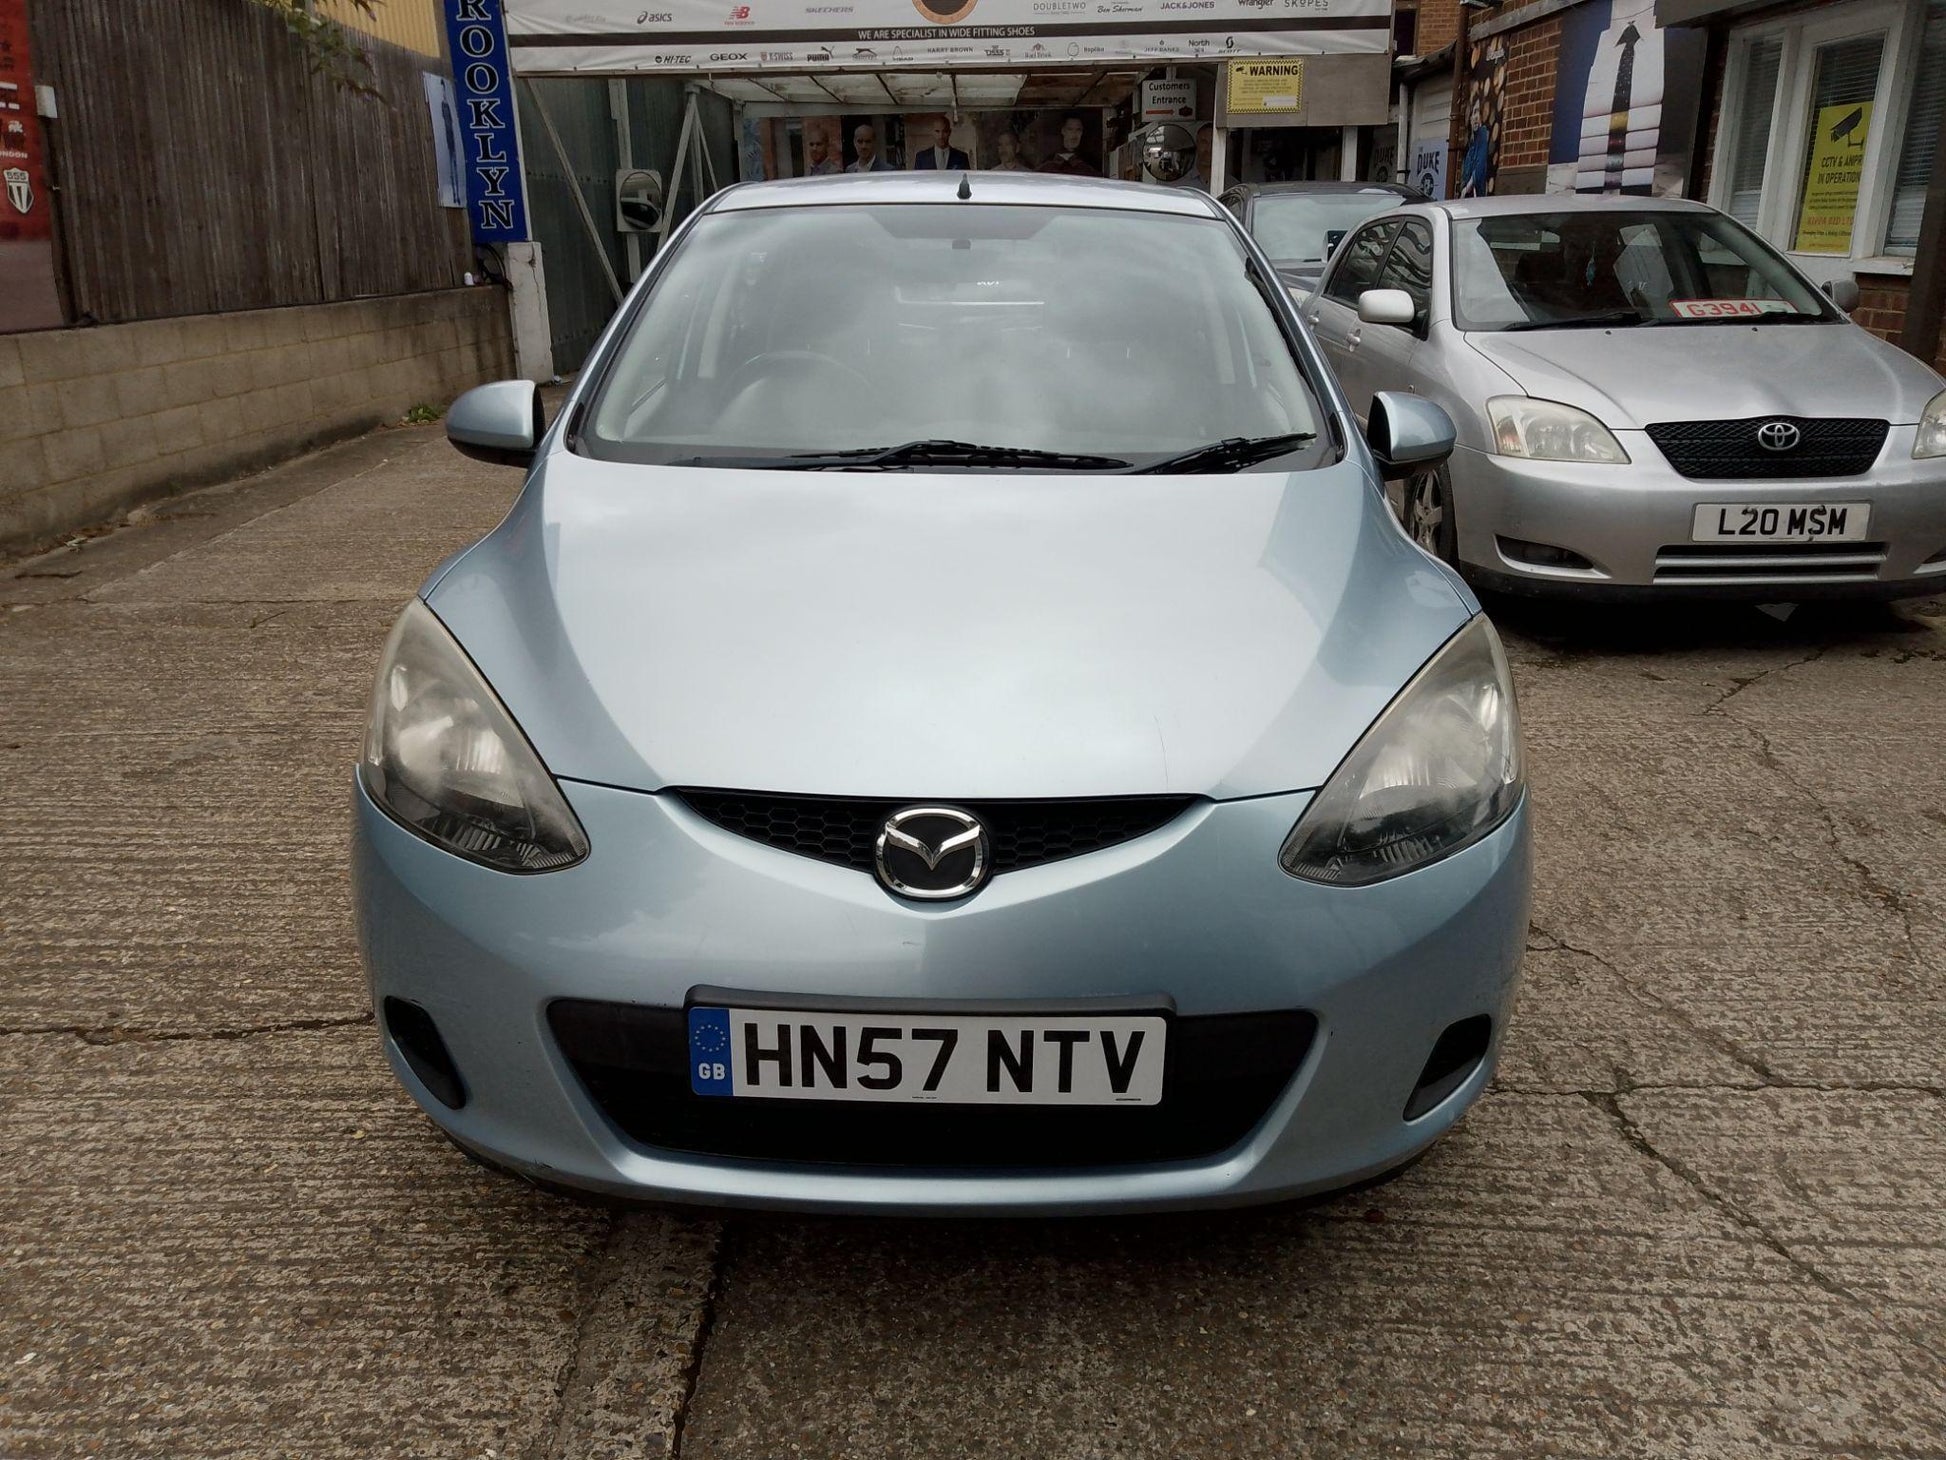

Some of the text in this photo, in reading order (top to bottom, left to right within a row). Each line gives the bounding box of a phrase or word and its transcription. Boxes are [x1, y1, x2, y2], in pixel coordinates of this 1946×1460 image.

[1033, 2, 1087, 11] DOUBLETWO
[1097, 5, 1143, 13] Ben Sherman
[1160, 1, 1215, 10] JACK&JONES
[858, 26, 1036, 40] WE ARE SPECIALIST IN WIDE FITTING SHOES
[1188, 39, 1210, 47] North
[663, 55, 692, 64] HI-TEC
[709, 53, 750, 62] GEOX
[1249, 65, 1299, 76] WARNING
[1148, 82, 1191, 91] Customers
[1152, 95, 1187, 105] Entrance
[456, 0, 515, 229] ROOKLYN
[0, 150, 28, 159] NDON
[1417, 151, 1441, 175] DUKE
[1821, 156, 1838, 168] CCTV
[1817, 172, 1825, 185] IN
[1718, 505, 1848, 536] L20 MSM
[744, 1022, 1146, 1095] HN57 NTV
[698, 1062, 726, 1080] GB
